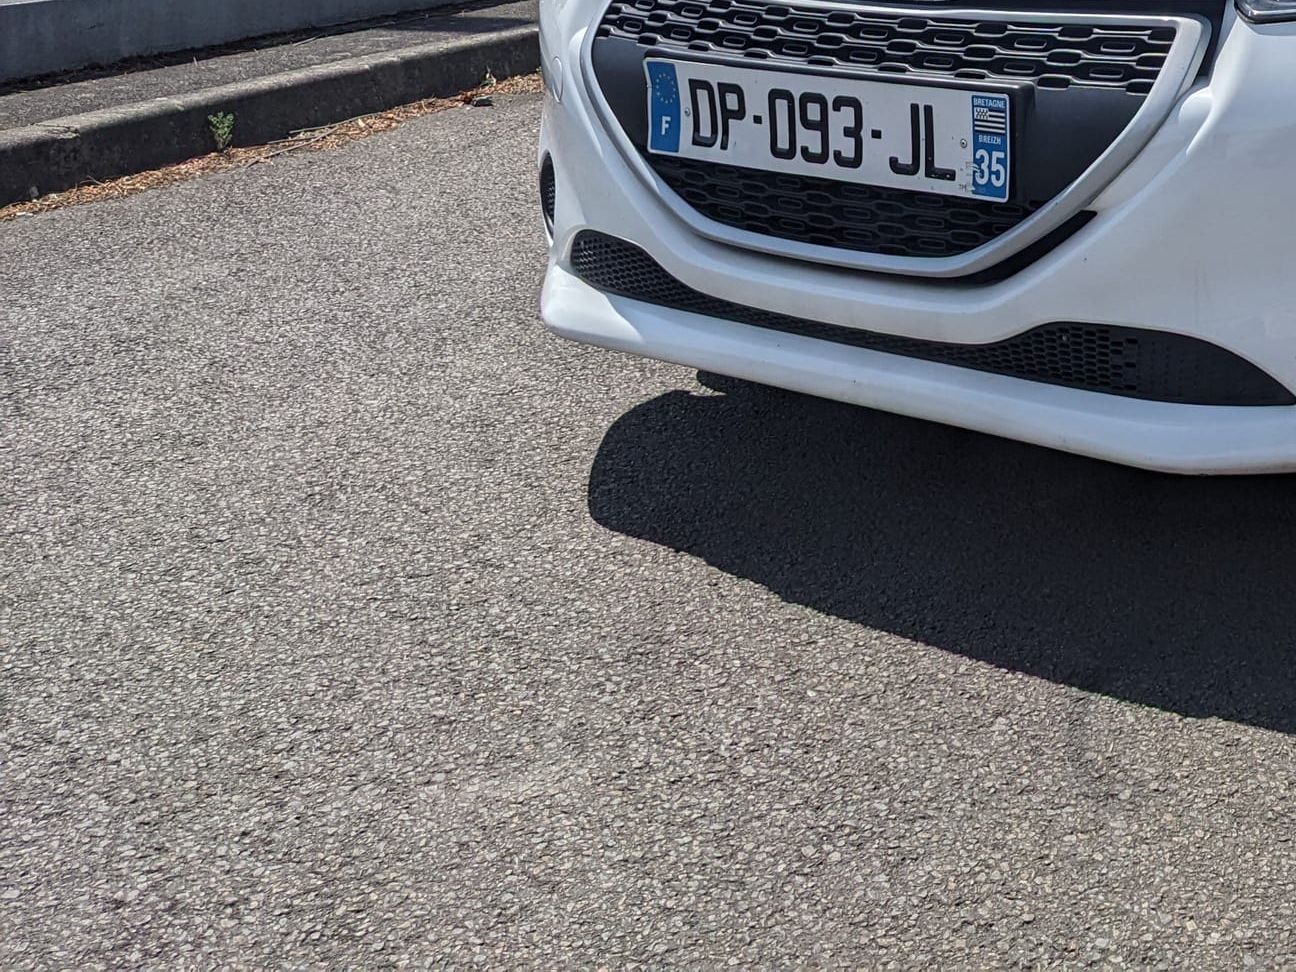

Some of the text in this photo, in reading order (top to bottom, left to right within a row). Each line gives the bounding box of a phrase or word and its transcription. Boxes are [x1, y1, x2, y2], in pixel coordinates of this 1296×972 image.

[973, 97, 1006, 109] BRETAGNE
[661, 116, 671, 136] F
[688, 78, 956, 181] DP-093-JL
[978, 134, 1002, 145] BREIZH
[974, 148, 1006, 188] 35
